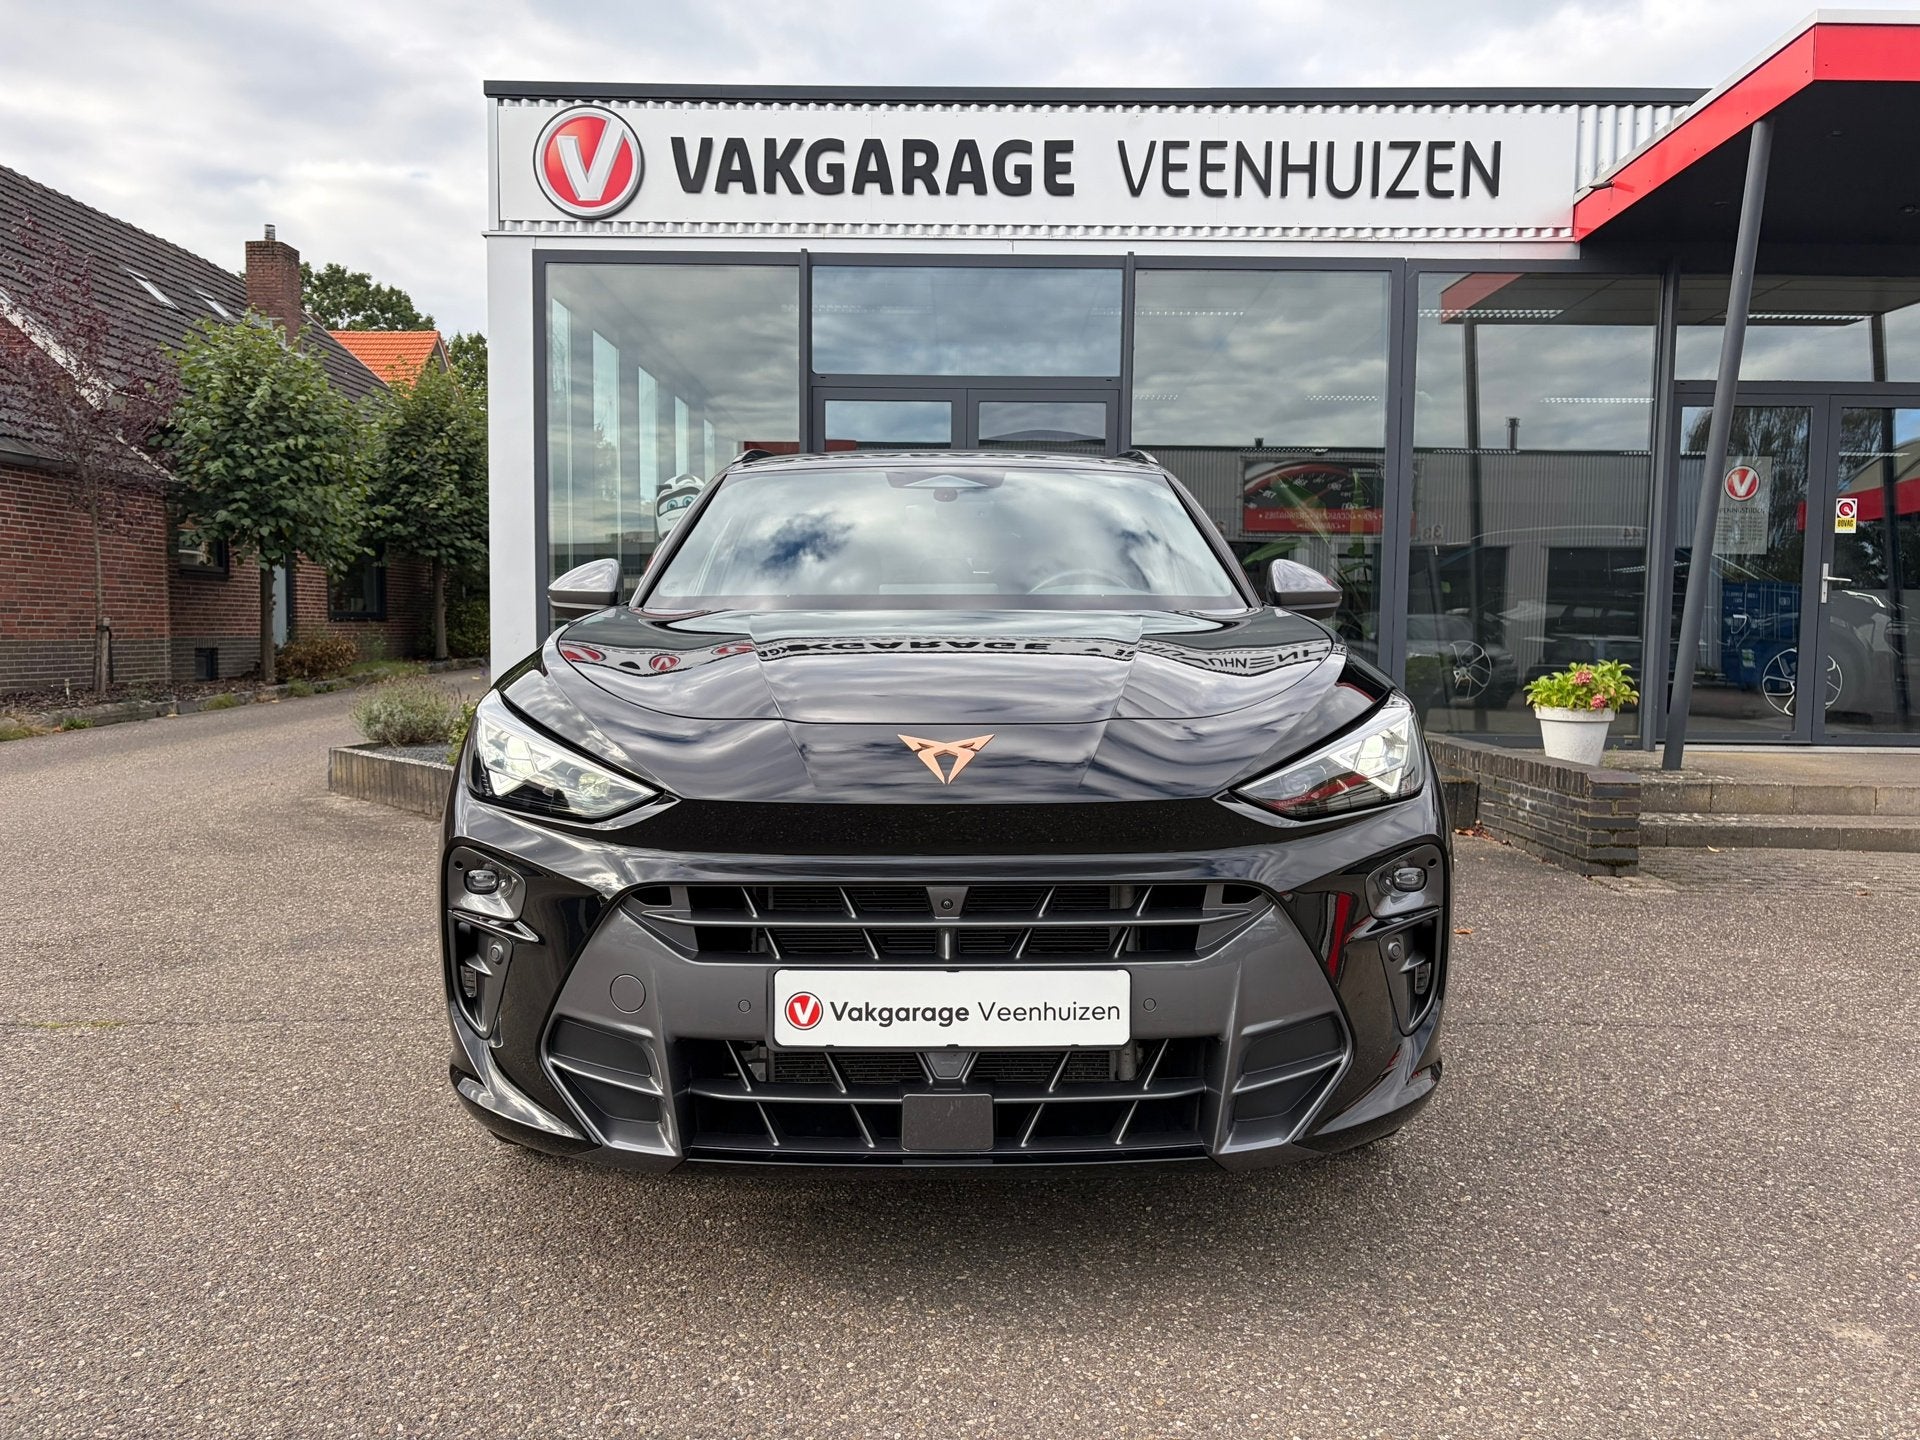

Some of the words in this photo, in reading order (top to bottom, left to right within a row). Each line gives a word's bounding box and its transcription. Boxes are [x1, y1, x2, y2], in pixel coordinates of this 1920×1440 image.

[671, 137, 1075, 197] VAKGARAGE
[1117, 140, 1502, 198] VEENHUIZEN
[1837, 519, 1854, 528] BOVAG
[830, 1001, 970, 1027] Vakgarage
[978, 1001, 1121, 1021] Veenhuizen
